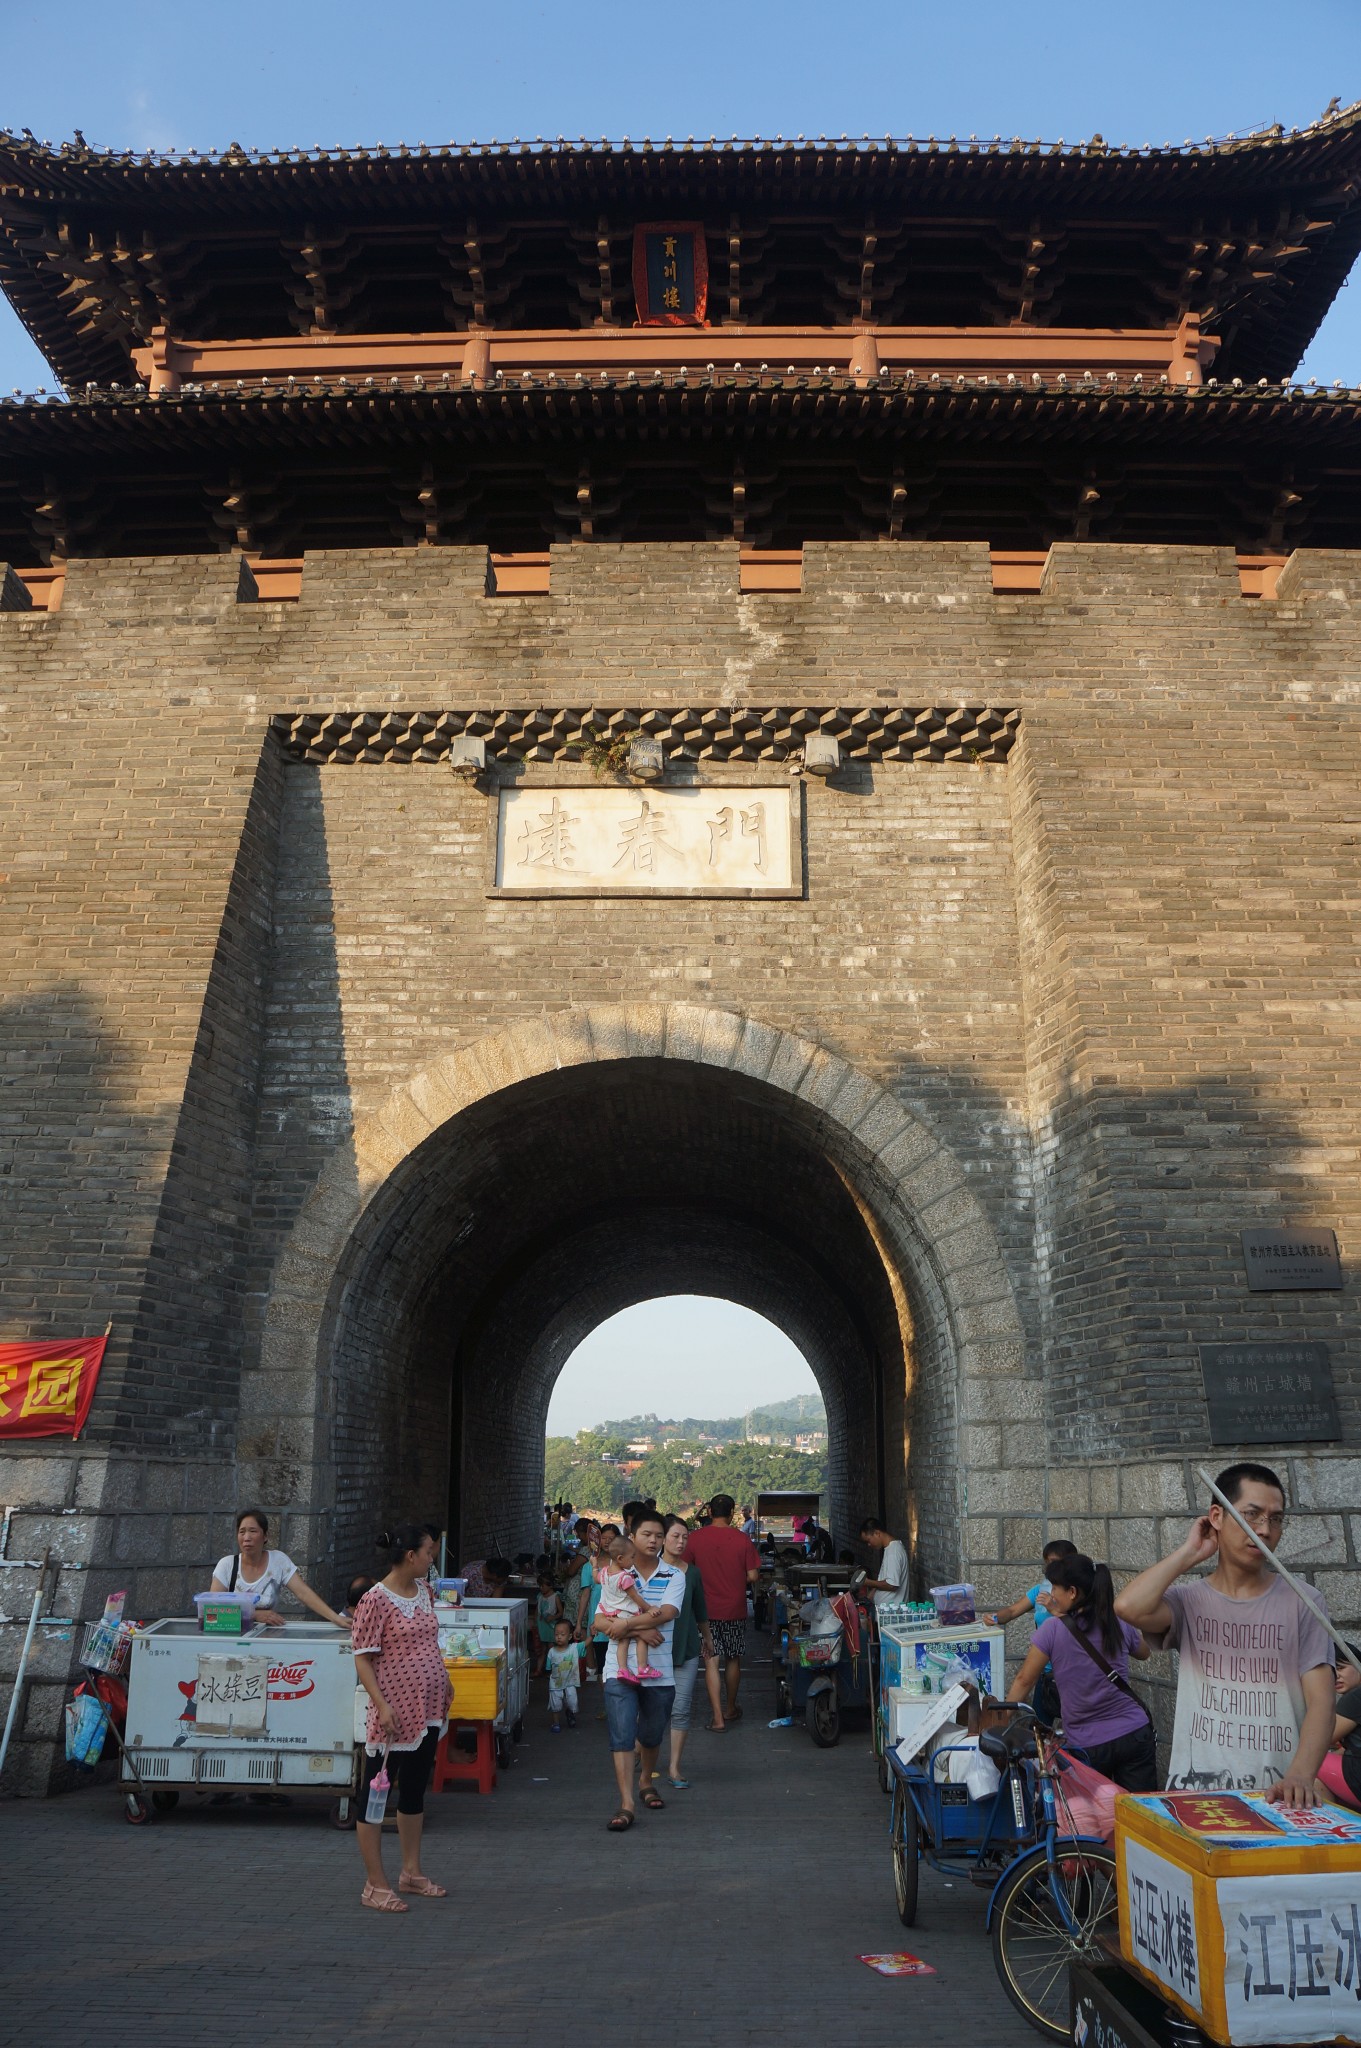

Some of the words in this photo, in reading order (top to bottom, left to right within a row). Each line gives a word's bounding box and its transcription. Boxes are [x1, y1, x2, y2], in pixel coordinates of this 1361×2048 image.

[1225, 1374, 1312, 1394] 赣州古城墙
[1196, 1615, 1219, 1645] CAN
[1222, 1621, 1285, 1651] SOMEONE
[1199, 1649, 1226, 1681] TELL
[1229, 1655, 1246, 1683] US
[1249, 1656, 1279, 1684] WHY
[1201, 1682, 1219, 1712] WE
[1189, 1711, 1215, 1743] JUST
[1217, 1719, 1235, 1749] BE
[1238, 1723, 1293, 1753] FRIENDS
[1131, 1872, 1196, 1996] 江压冰棒
